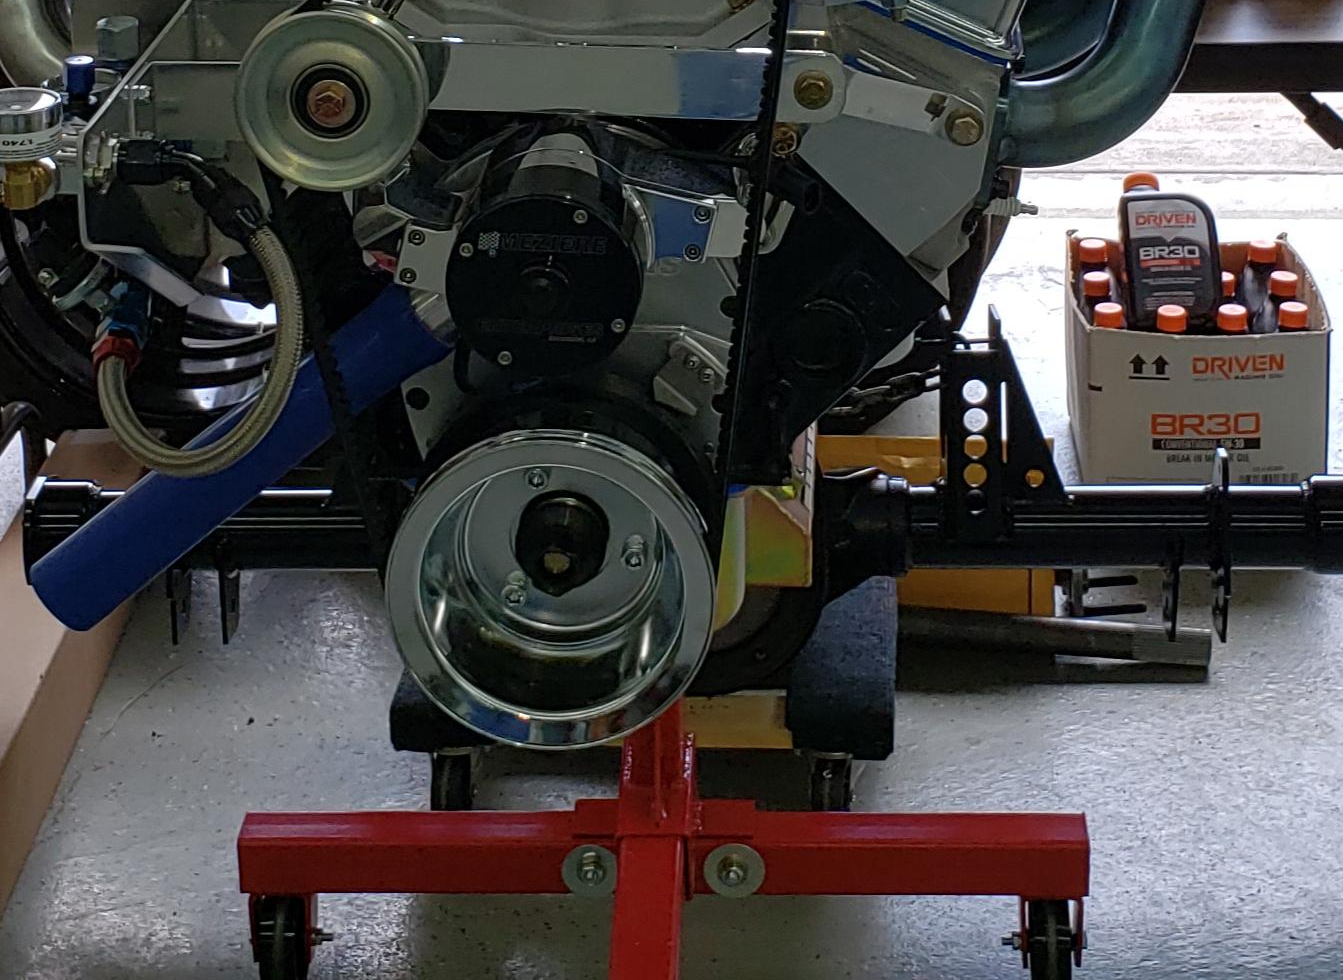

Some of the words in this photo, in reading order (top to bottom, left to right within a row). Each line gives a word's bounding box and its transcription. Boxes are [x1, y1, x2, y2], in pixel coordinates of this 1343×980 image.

[1135, 212, 1197, 228] DRIVEN
[501, 233, 609, 256] MEZIERE
[1139, 245, 1200, 259] BR30
[1192, 354, 1285, 379] DRIVEN
[1151, 412, 1261, 436] BR30
